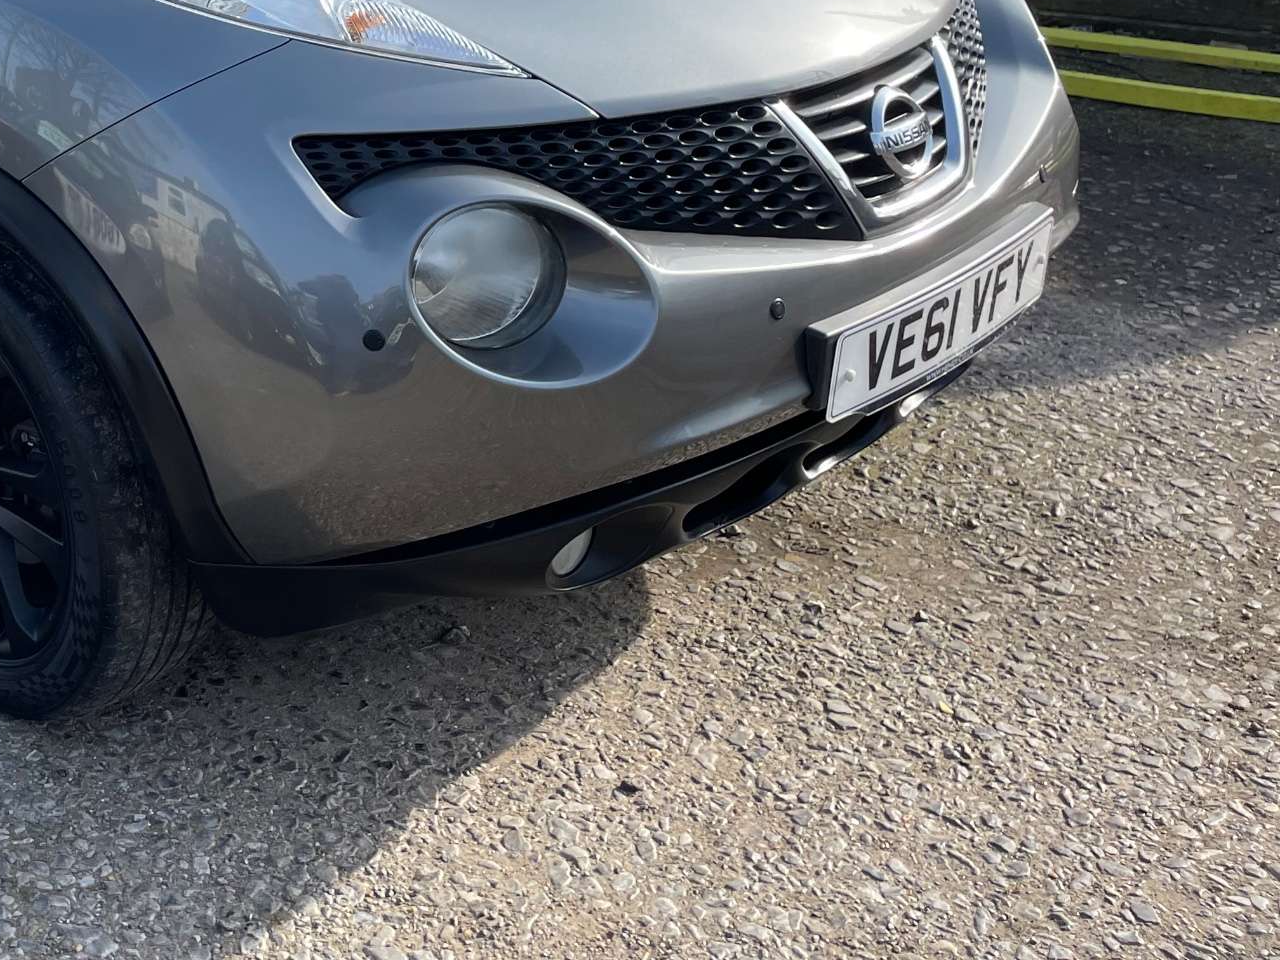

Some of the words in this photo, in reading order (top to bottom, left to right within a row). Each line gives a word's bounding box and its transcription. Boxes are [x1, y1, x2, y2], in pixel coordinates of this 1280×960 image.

[885, 120, 931, 148] NISSAN
[867, 287, 961, 391] VE61
[971, 239, 1035, 334] VFY
